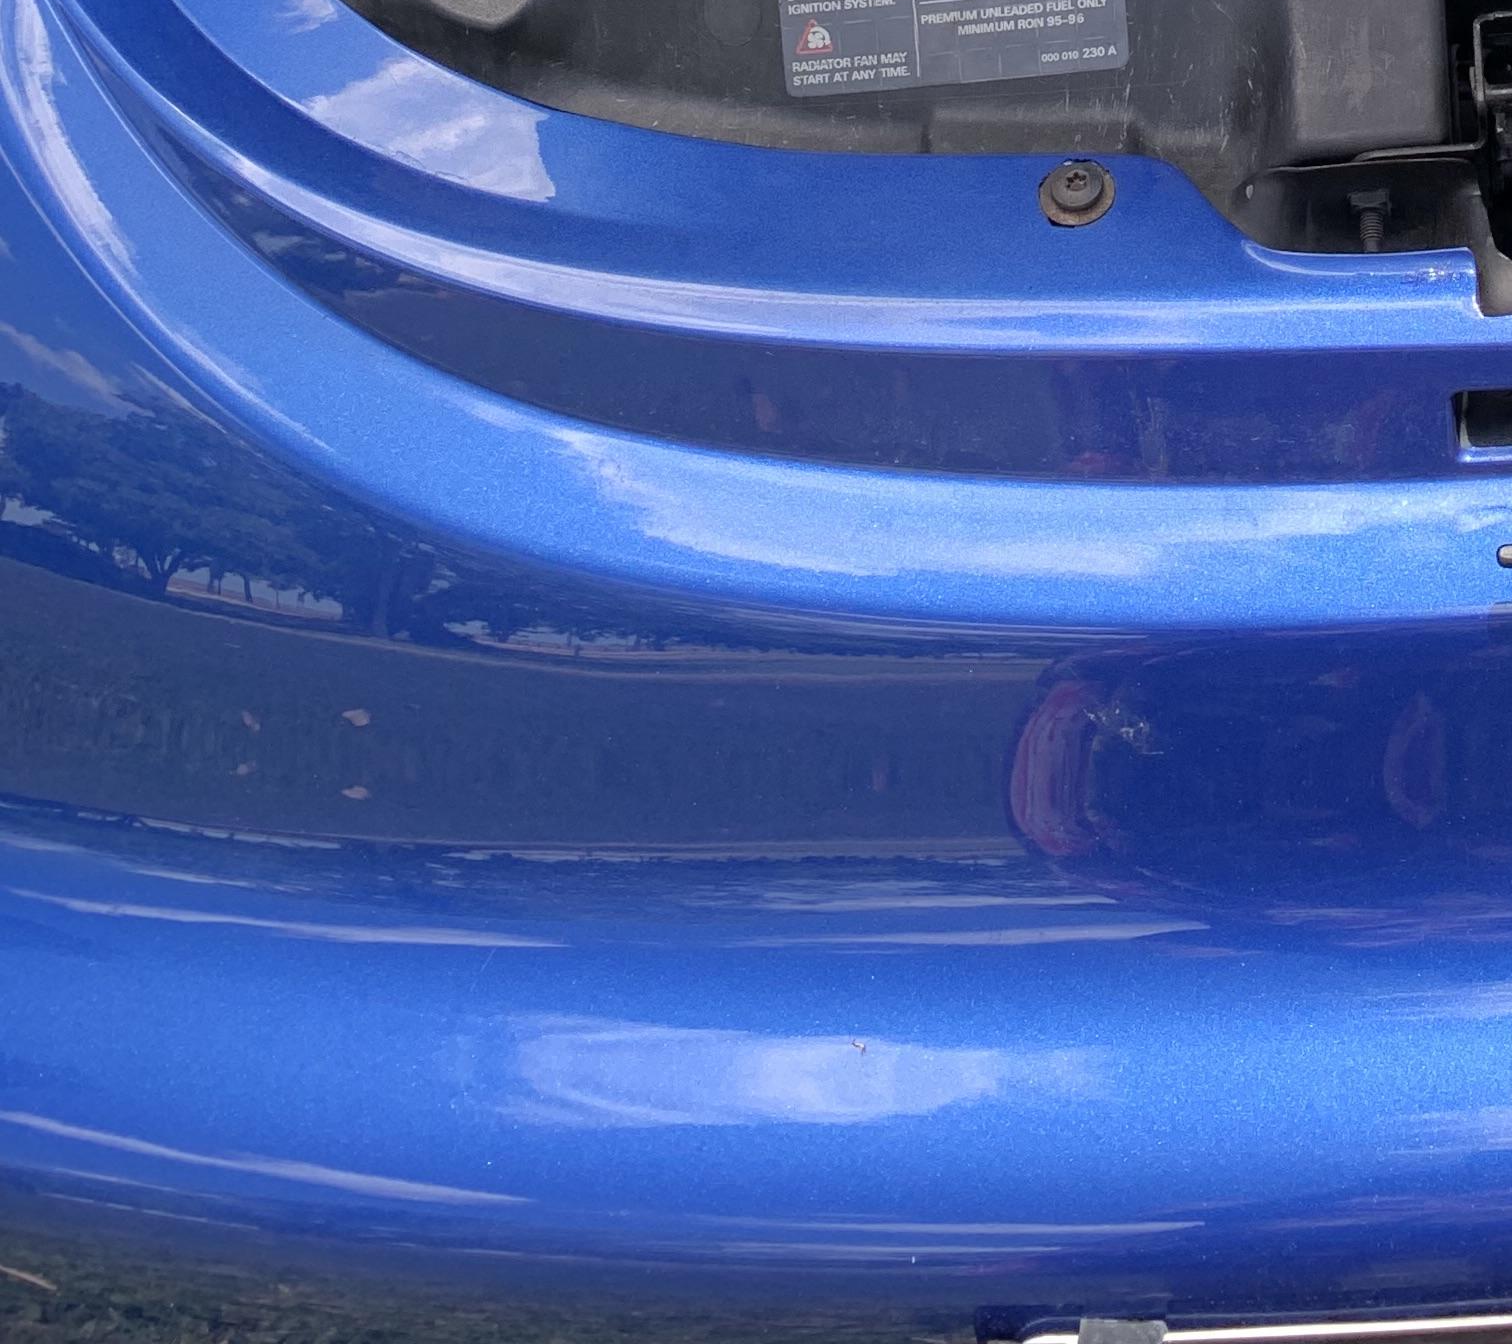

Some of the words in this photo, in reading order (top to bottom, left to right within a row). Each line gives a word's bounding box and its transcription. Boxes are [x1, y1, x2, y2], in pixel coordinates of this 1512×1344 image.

[788, 0, 841, 15] IGNITION
[920, 10, 978, 25] PREMIUM
[981, 4, 1043, 19] UNLEADED
[1046, 0, 1075, 12] FUEL
[958, 20, 1015, 36] MINIMUM
[1017, 17, 1044, 30] RON
[792, 57, 852, 72] RADIATOR
[854, 54, 878, 67] FAN
[880, 52, 908, 64] MAY
[1041, 52, 1060, 63] 000
[1061, 51, 1079, 60] 010
[1082, 47, 1105, 59] 230
[1108, 45, 1117, 56] A
[793, 73, 831, 86] START
[833, 71, 849, 82] AT
[851, 69, 876, 81] ANY
